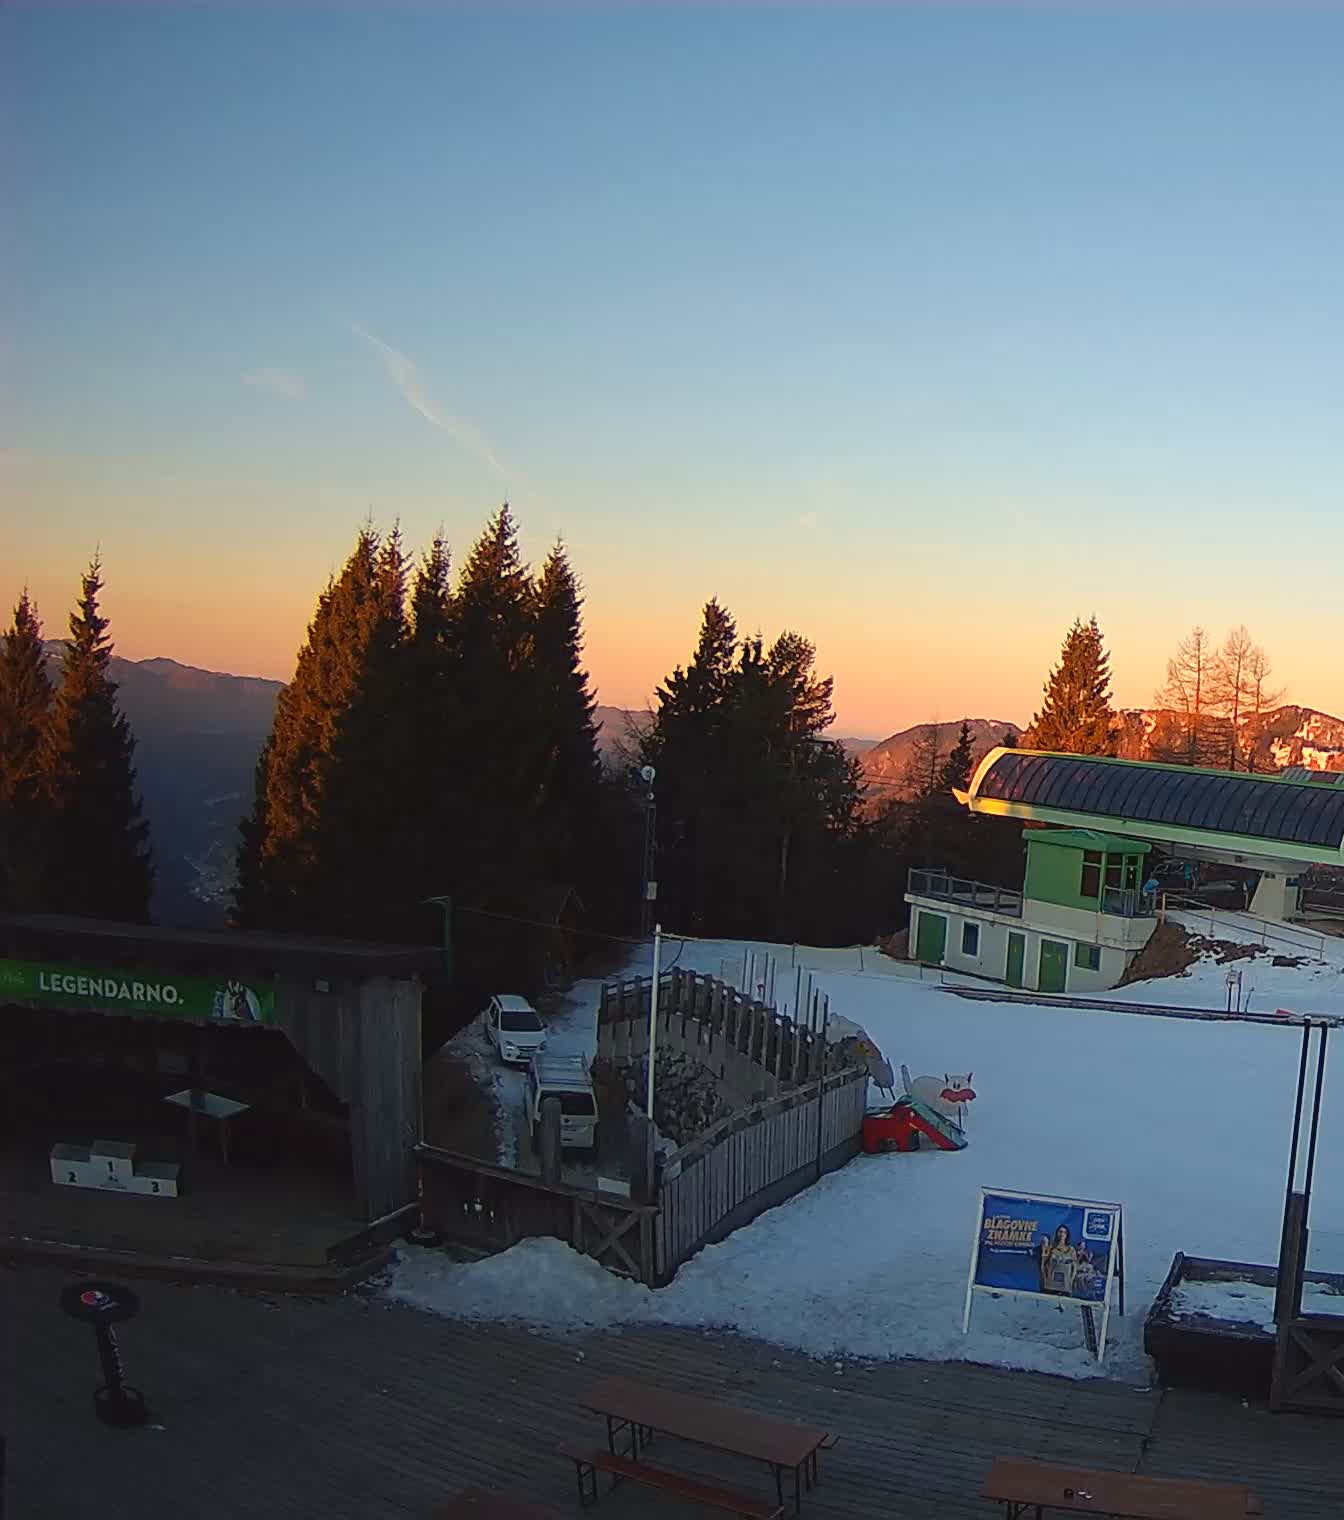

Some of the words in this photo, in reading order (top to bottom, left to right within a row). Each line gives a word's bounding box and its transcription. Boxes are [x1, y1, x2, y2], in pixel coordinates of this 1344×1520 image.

[39, 971, 185, 1005] LEGENDARNO.
[67, 1171, 77, 1183] 2
[151, 1181, 160, 1193] 3
[984, 1218, 1039, 1232] BLAGOVNE
[986, 1230, 1033, 1242] ZNAMKE
